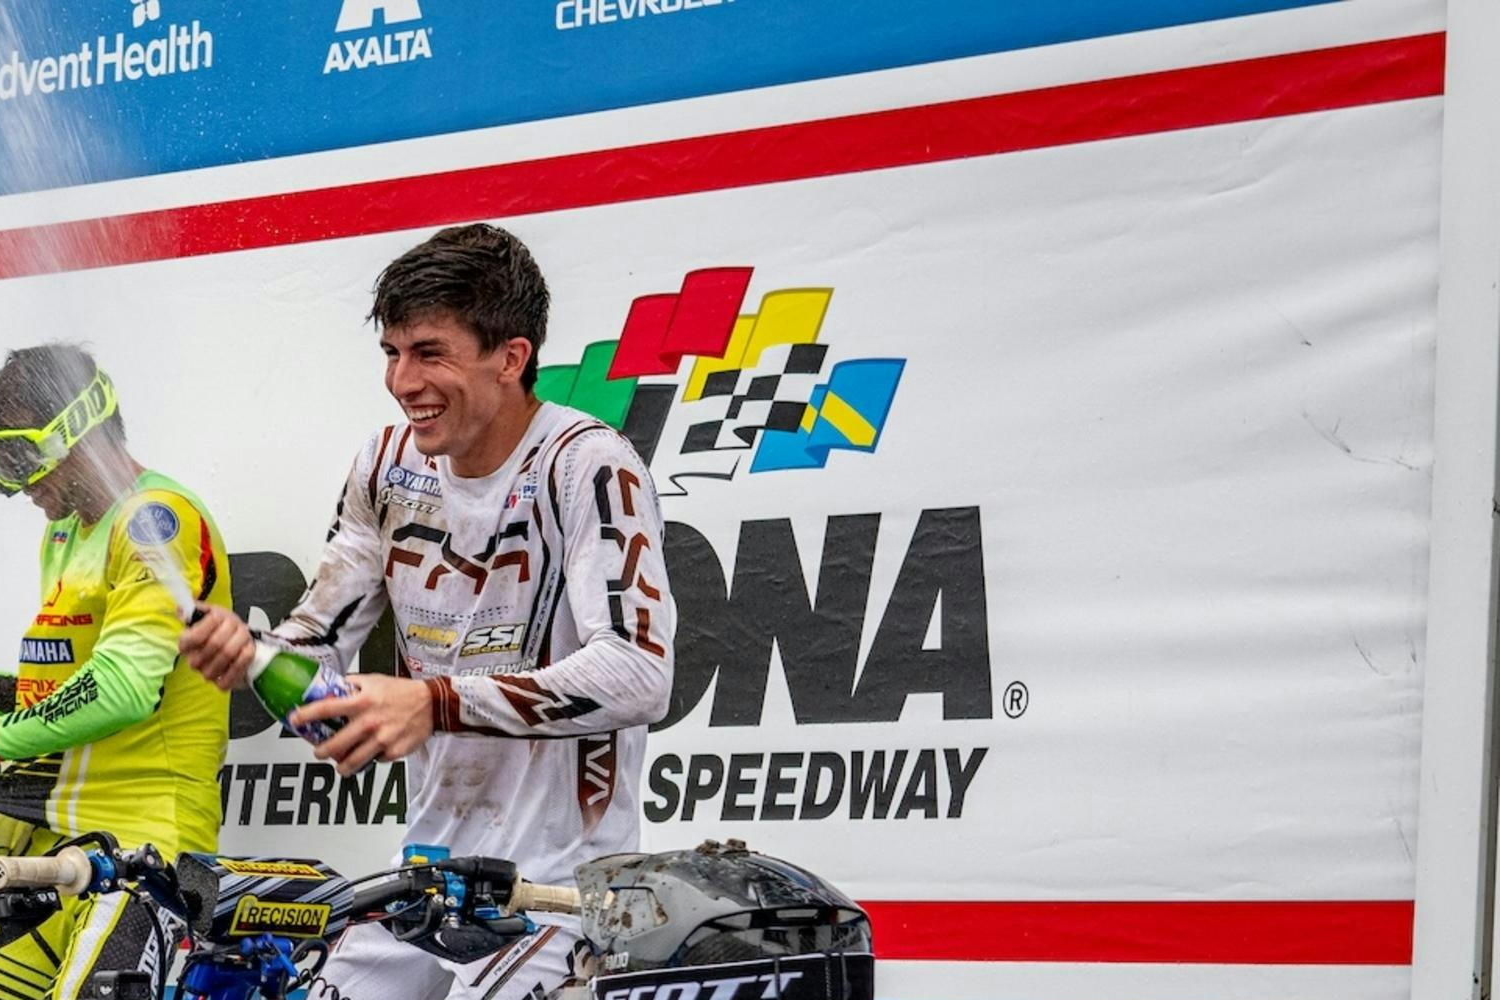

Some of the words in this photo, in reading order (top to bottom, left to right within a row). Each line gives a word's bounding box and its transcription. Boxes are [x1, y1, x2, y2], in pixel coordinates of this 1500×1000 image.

[323, 30, 427, 75] AXALTA
[389, 495, 442, 515] SCOTT
[20, 639, 72, 663] AMAHA
[464, 624, 523, 651] SSI
[643, 747, 990, 823] SPEEDWAY
